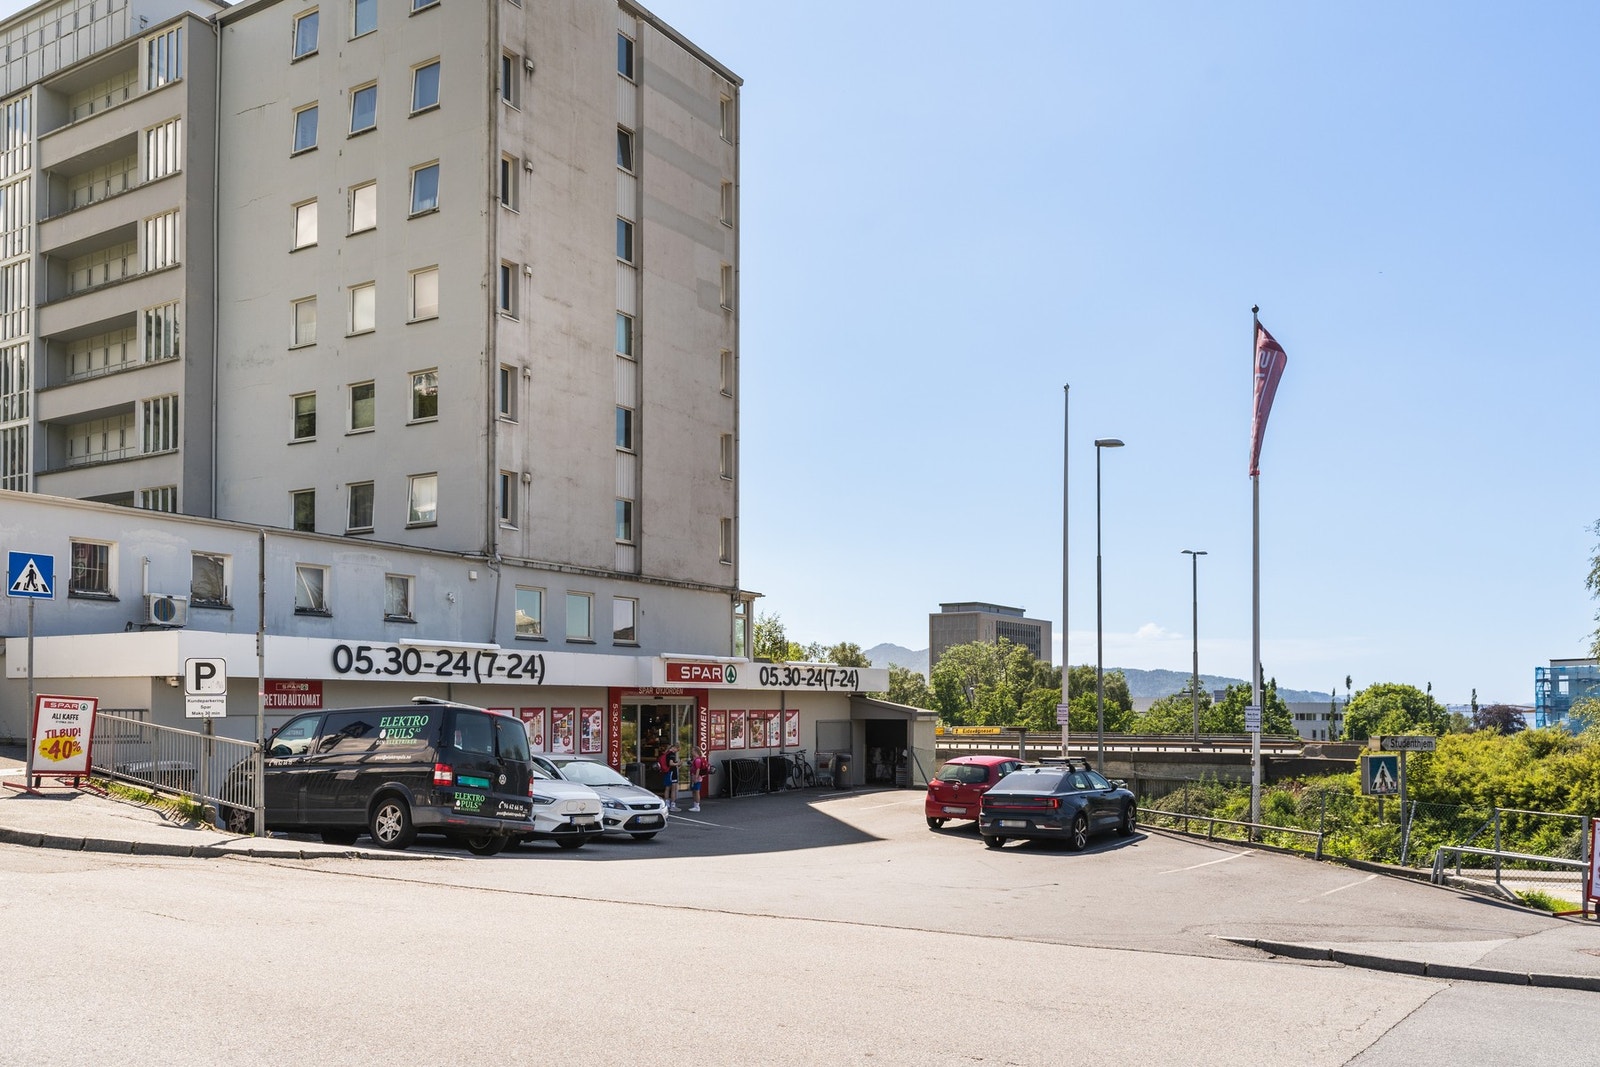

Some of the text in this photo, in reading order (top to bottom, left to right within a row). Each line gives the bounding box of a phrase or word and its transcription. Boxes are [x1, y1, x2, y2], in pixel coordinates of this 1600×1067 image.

[195, 662, 216, 690] P
[681, 666, 722, 679] SPAR
[379, 715, 429, 727] ELEKTRO
[45, 728, 82, 739] TILBUD!
[386, 728, 415, 739] PULS
[42, 740, 81, 759] -40%
[1390, 738, 1434, 750] Studenthjem
[454, 792, 486, 802] ELEKTRO
[460, 800, 479, 809] PULS
